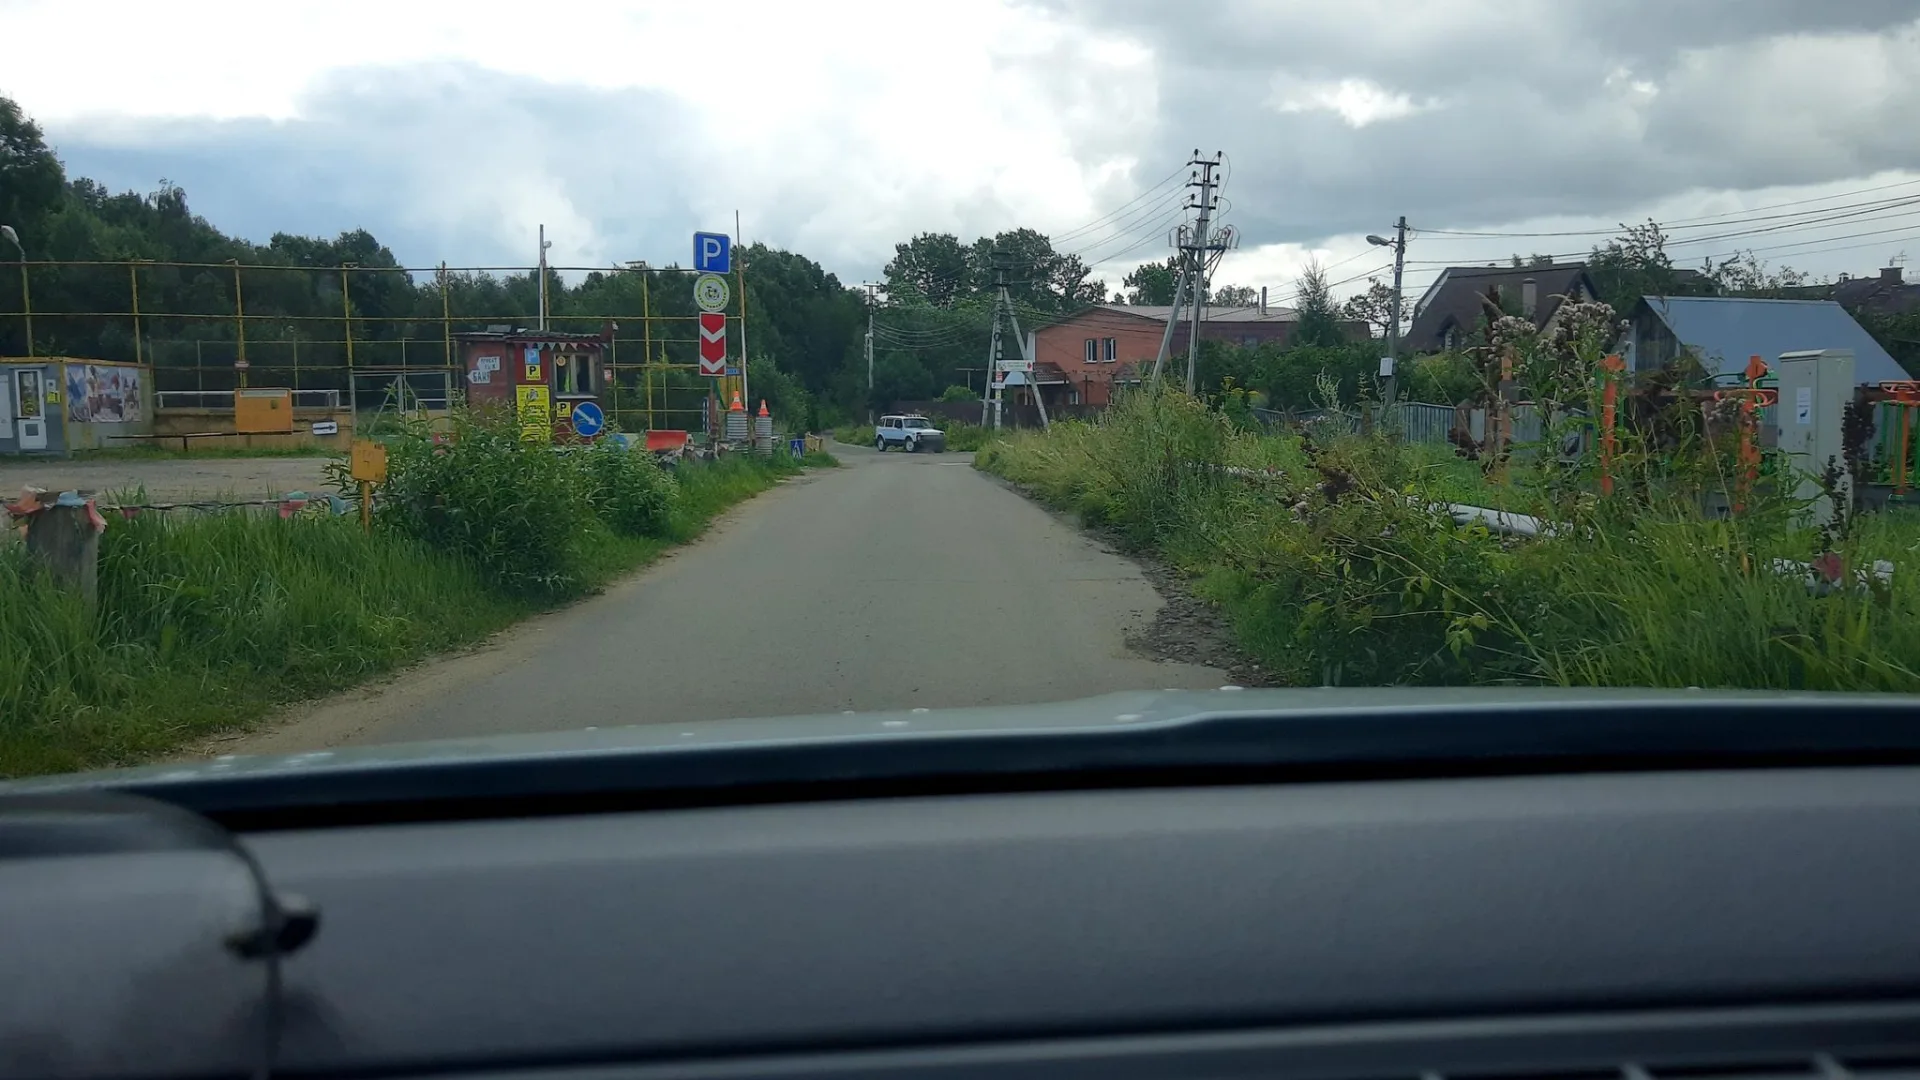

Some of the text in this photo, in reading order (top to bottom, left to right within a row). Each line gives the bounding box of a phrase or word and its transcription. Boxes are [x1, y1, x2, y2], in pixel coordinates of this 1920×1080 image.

[703, 238, 721, 268] P
[529, 366, 536, 375] P
[560, 403, 567, 412] P
